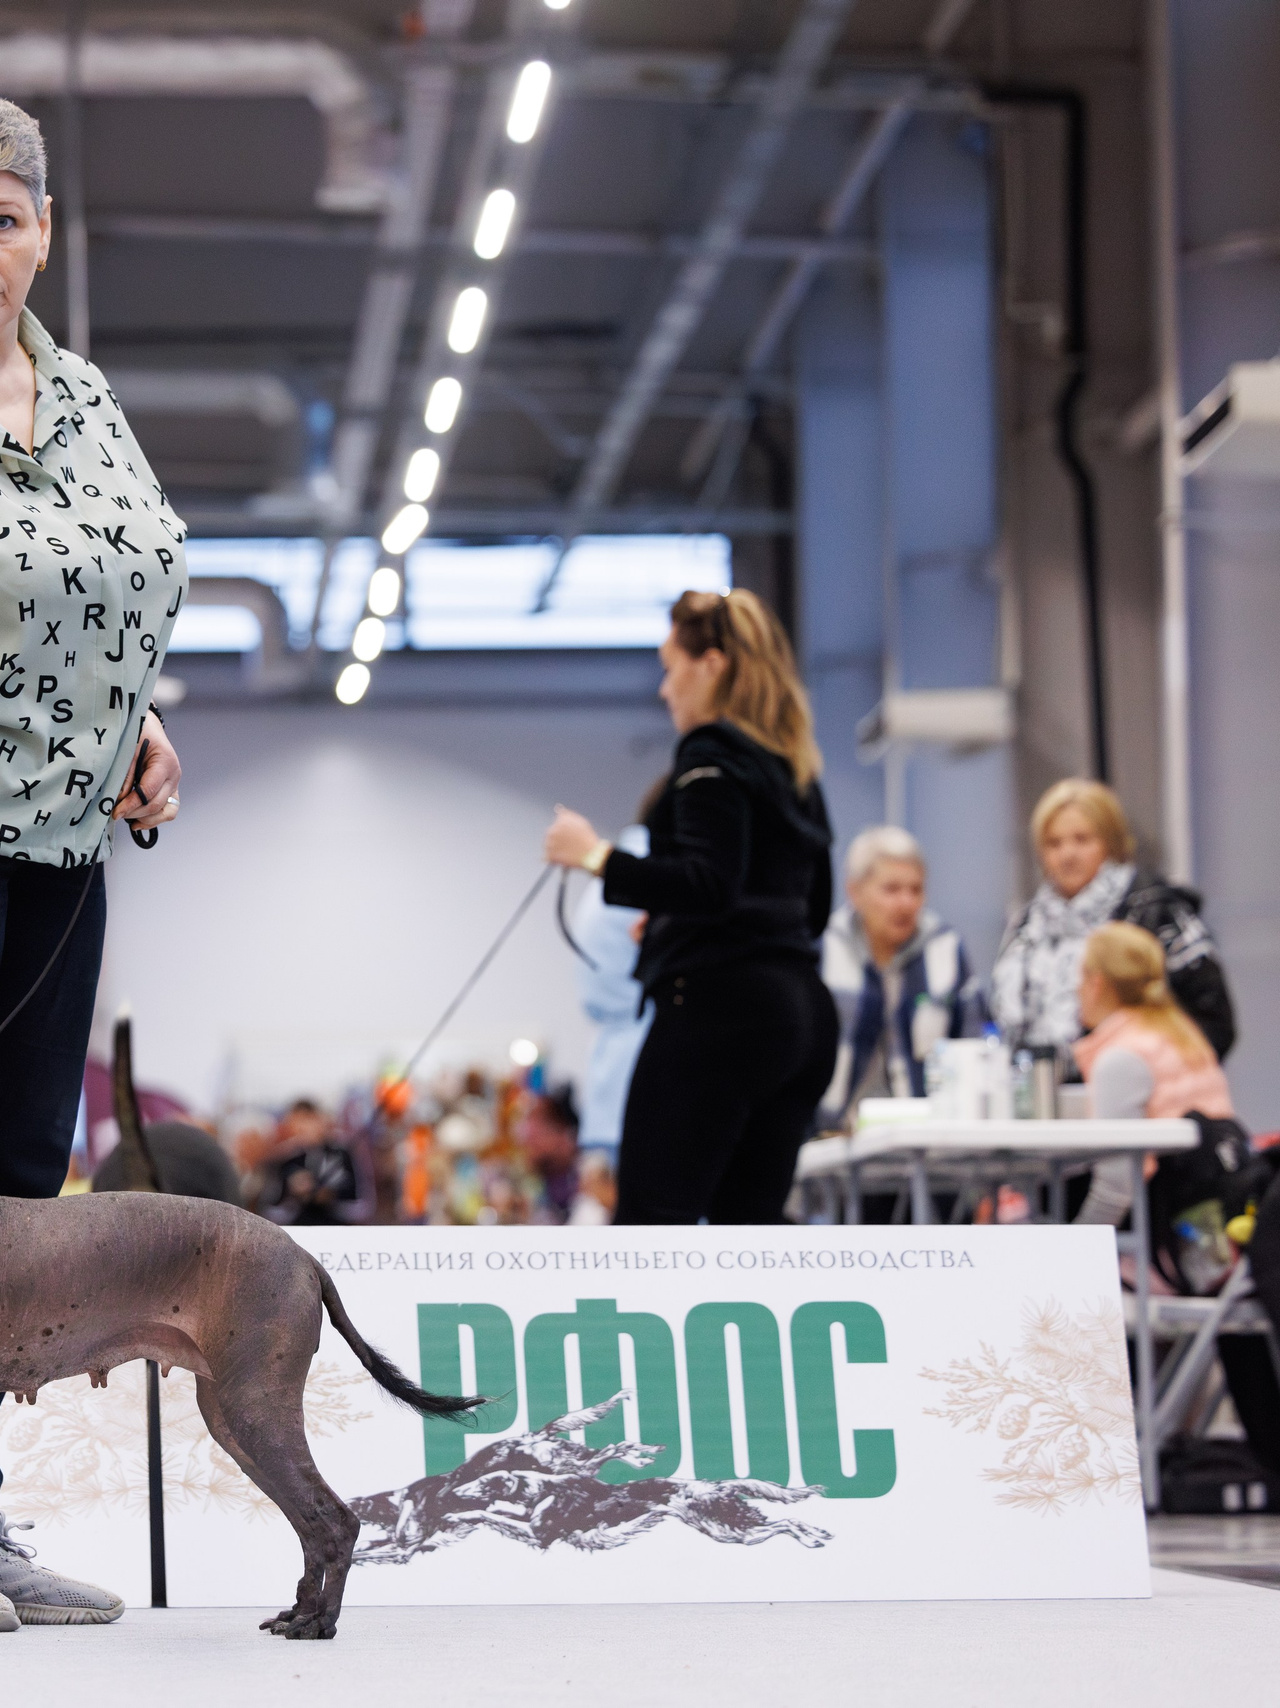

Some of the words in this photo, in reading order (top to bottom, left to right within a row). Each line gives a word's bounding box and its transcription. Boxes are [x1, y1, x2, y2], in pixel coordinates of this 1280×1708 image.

[106, 423, 122, 438] Z
[99, 443, 114, 468] J
[6, 471, 40, 493] R
[60, 467, 76, 483] W
[51, 482, 71, 508] J
[83, 485, 102, 497] Q
[111, 496, 132, 510] W
[17, 520, 36, 539] P
[103, 526, 142, 554] K
[47, 538, 69, 555] S
[15, 553, 33, 571] Z
[91, 556, 104, 573] Y
[155, 548, 173, 574] P
[62, 567, 87, 595] K
[131, 572, 145, 591] O
[19, 599, 34, 622] H
[166, 586, 182, 618] J
[83, 603, 106, 630] R
[124, 611, 141, 629] W
[41, 621, 61, 645] X
[140, 634, 155, 652] Q
[105, 629, 124, 662] J
[0, 653, 19, 670] K
[65, 651, 76, 667] H
[0, 667, 25, 698] C
[36, 675, 57, 703] P
[51, 699, 73, 723] S
[94, 728, 107, 745] Y
[48, 737, 76, 764] K
[12, 779, 41, 800] X
[65, 769, 94, 799] R
[34, 810, 51, 827] H
[70, 799, 92, 826] J
[485, 1250, 707, 1271] ОХОТНИЧЬЕГО
[716, 1249, 976, 1272] СОБАКОВОДСТВА
[416, 1297, 898, 1499] РФОС
